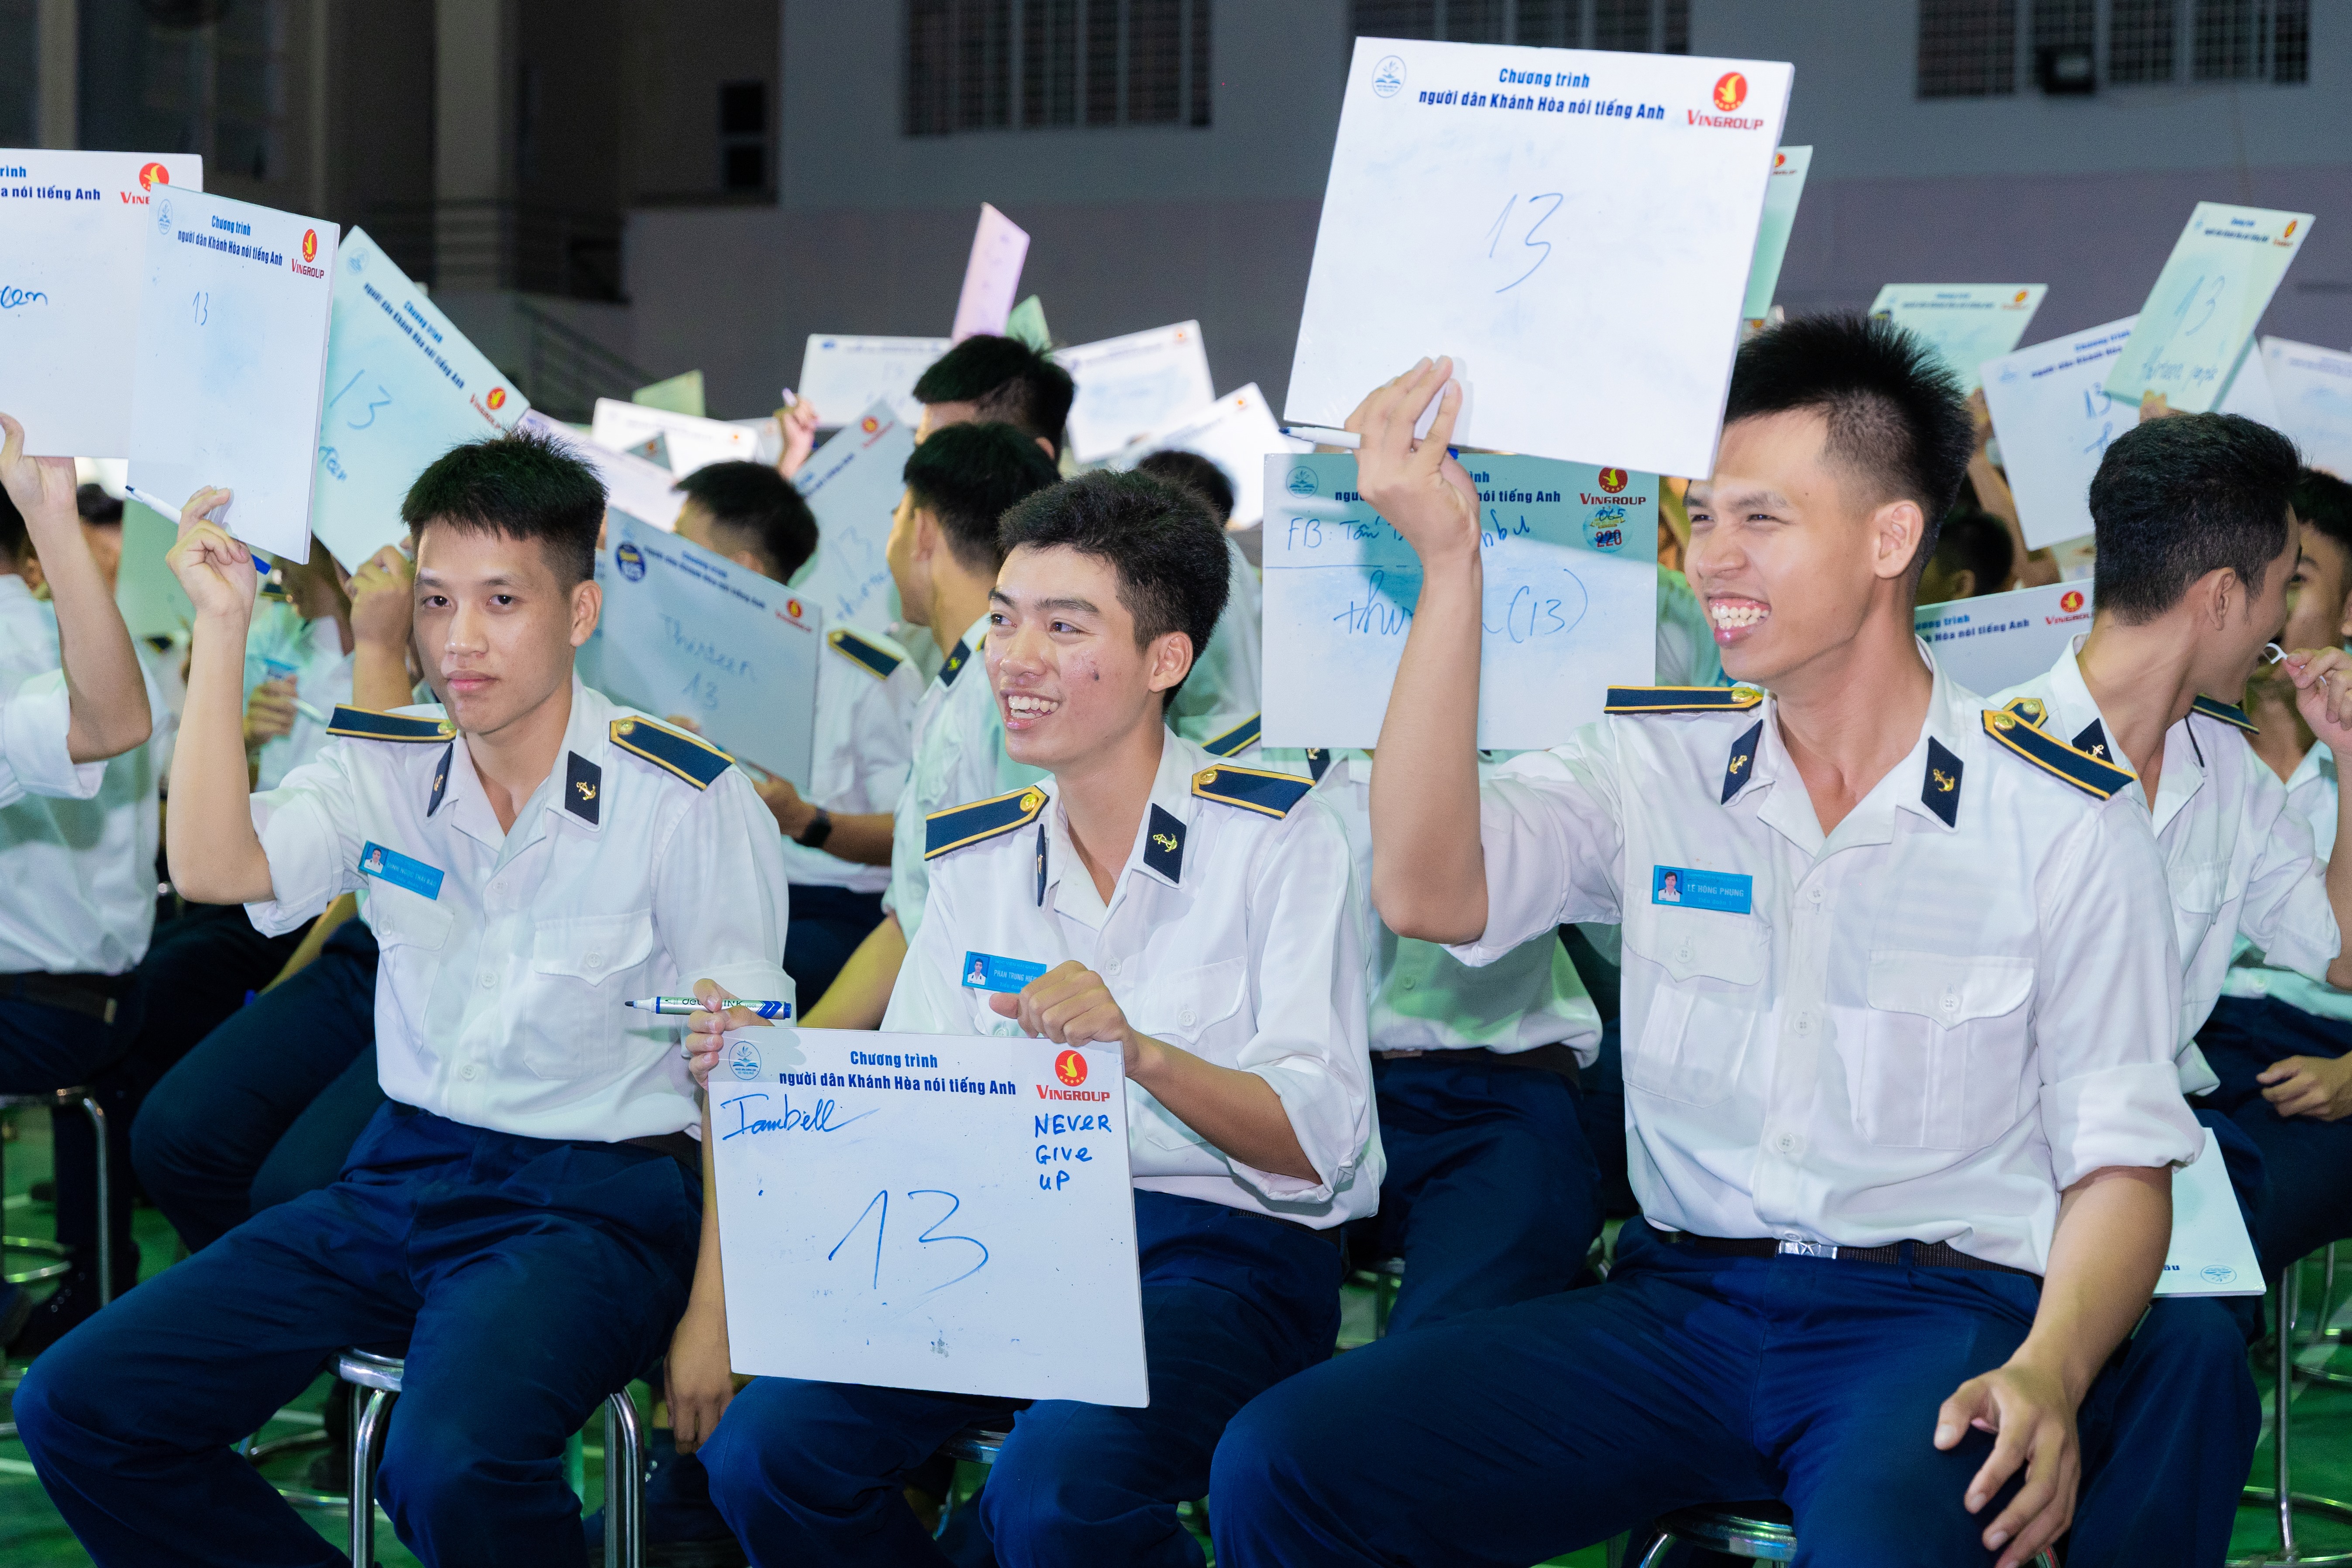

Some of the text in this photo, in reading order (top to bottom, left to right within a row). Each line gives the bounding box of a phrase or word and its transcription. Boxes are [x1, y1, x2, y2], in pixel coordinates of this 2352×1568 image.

[1499, 68, 1590, 88] Chương trình
[1419, 90, 1665, 119] người dân Khánh Hòa nói tiếng Anh
[0, 165, 27, 178] rình
[12, 186, 33, 198] nói
[37, 185, 71, 201] tiếng
[75, 188, 100, 200] Anh
[211, 214, 251, 236] Chương trình
[178, 229, 283, 266] người dân Khánh Hòa nói tiếng Anh
[1485, 193, 1563, 293] 13
[193, 291, 209, 326] 13
[328, 369, 392, 430] 13
[1499, 488, 1532, 503] tiếng
[1536, 490, 1561, 503] Anh
[1579, 492, 1646, 505] VINGROUP
[1508, 569, 1588, 643] (13)
[851, 1051, 938, 1068] Chương trình
[779, 1072, 816, 1086] người
[820, 1072, 845, 1087] dân
[848, 1074, 891, 1089] Khánh
[924, 1077, 946, 1092] nói
[949, 1076, 986, 1096] tiếng
[989, 1080, 1016, 1096] Anh
[1036, 1084, 1110, 1102] VINGROUP
[828, 1189, 988, 1295] 13
